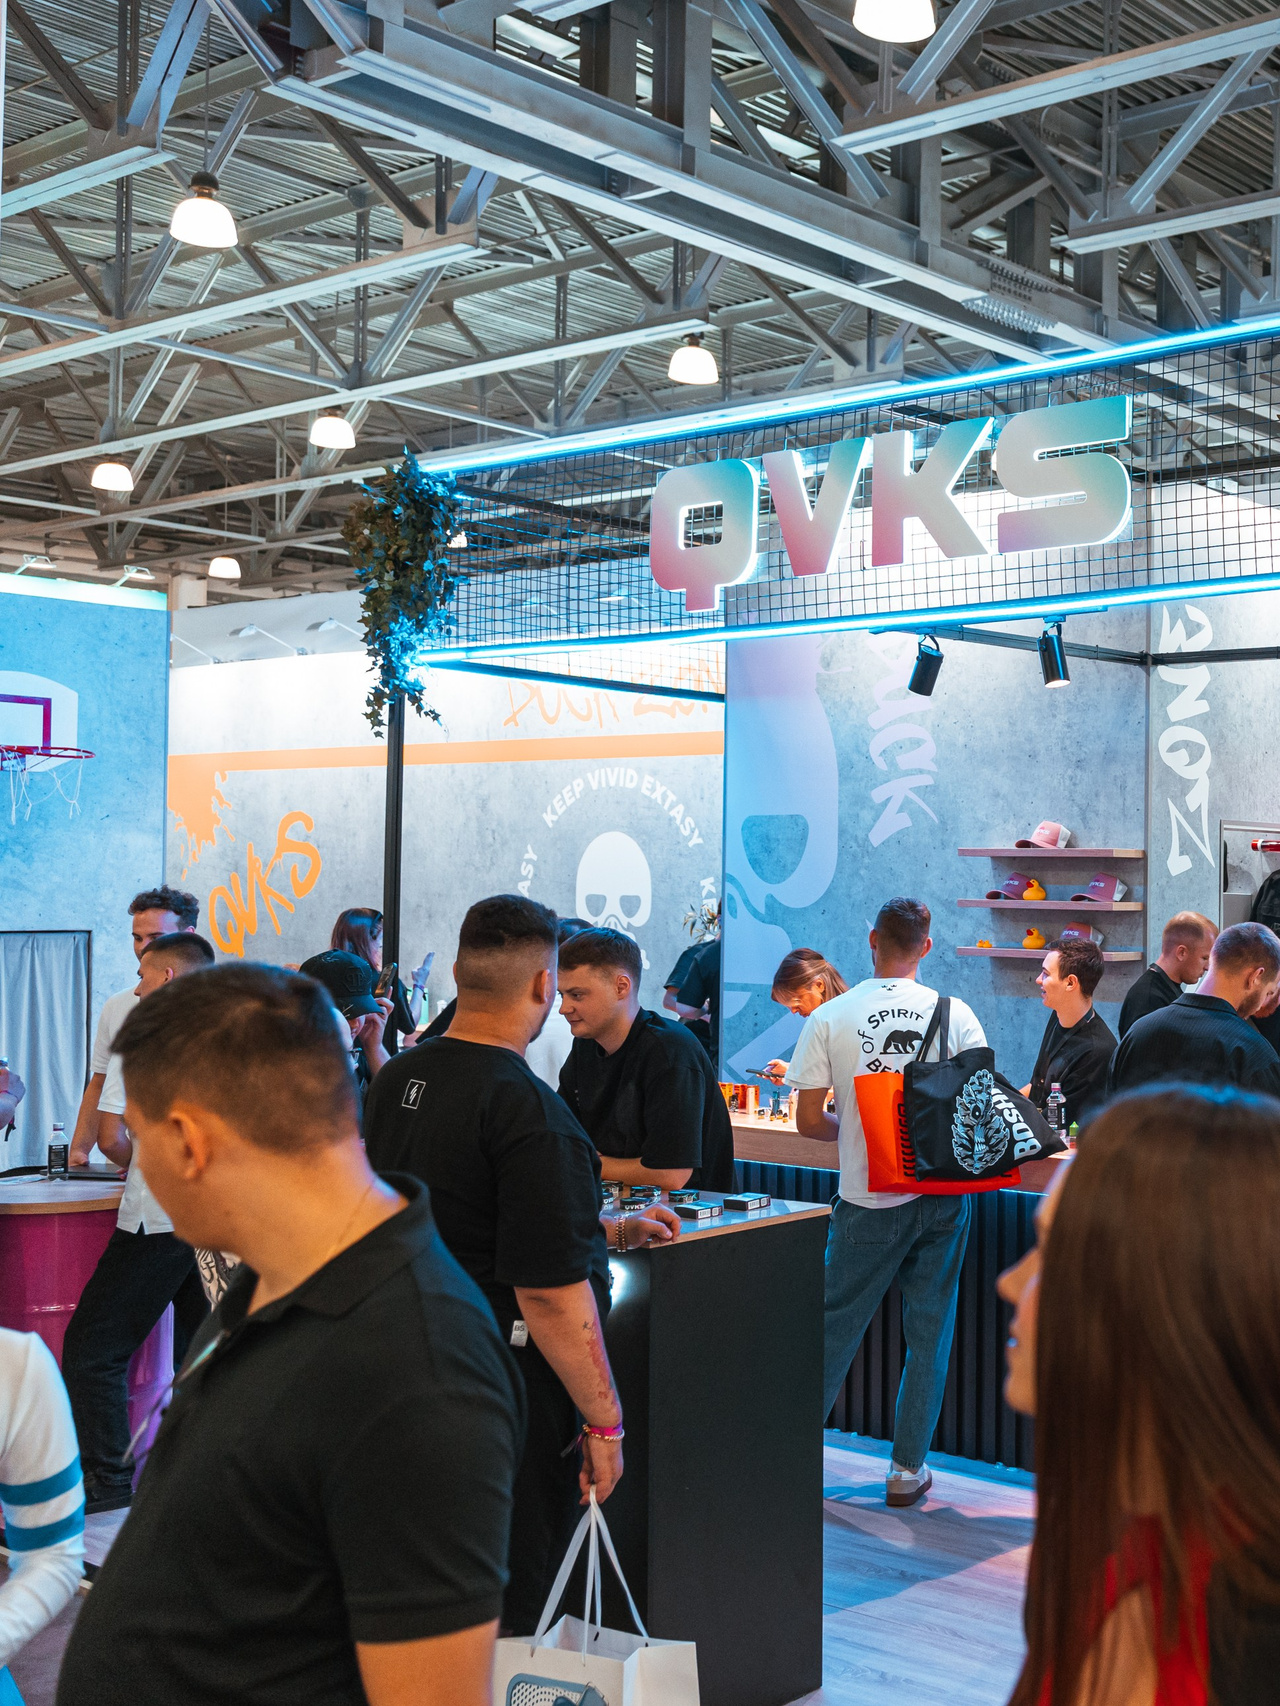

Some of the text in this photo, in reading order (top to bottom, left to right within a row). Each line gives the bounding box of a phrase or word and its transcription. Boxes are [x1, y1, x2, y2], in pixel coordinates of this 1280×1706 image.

[649, 394, 1134, 613] QVKS
[541, 766, 704, 849] KEEP VIVID EXTASY
[208, 810, 323, 958] QVKS
[517, 844, 538, 898] ASY
[867, 1008, 924, 1029] SPIRIT
